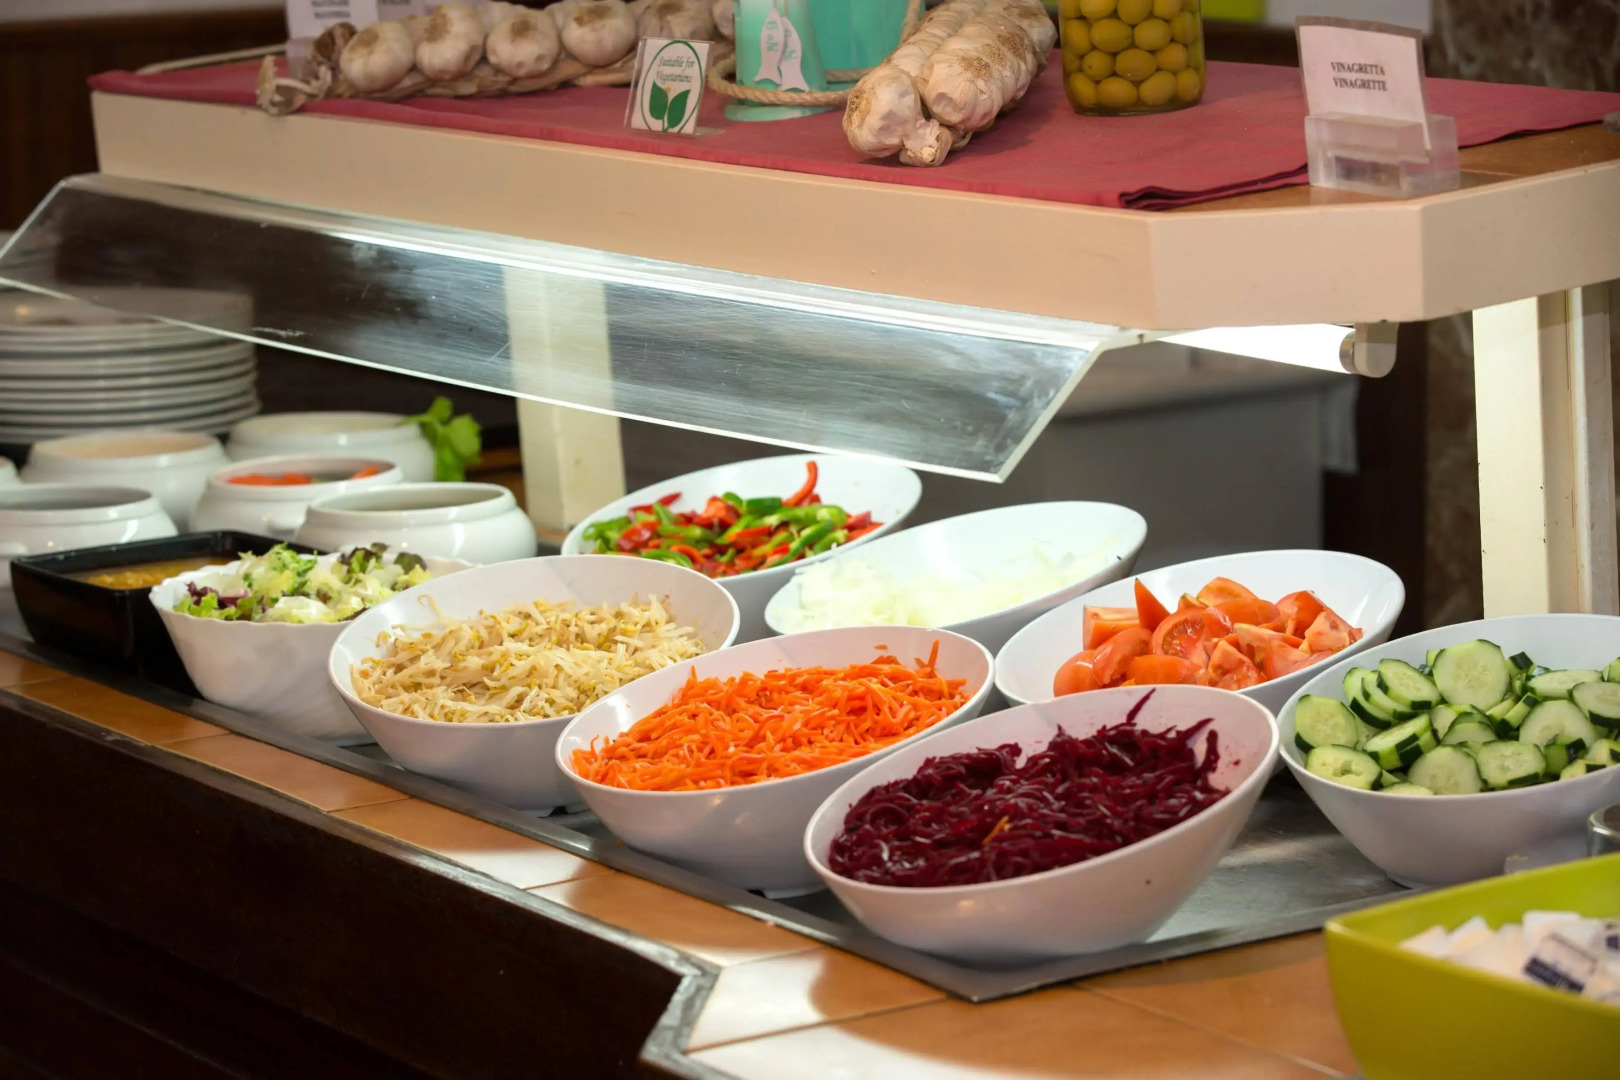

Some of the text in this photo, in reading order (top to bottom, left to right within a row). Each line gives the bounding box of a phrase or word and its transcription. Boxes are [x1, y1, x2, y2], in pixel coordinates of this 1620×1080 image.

[657, 55, 695, 72] Suitable for
[1330, 61, 1386, 76] VINAGRETTA
[656, 70, 692, 85] Vegetarians
[1332, 77, 1388, 92] VINAGRETTE
